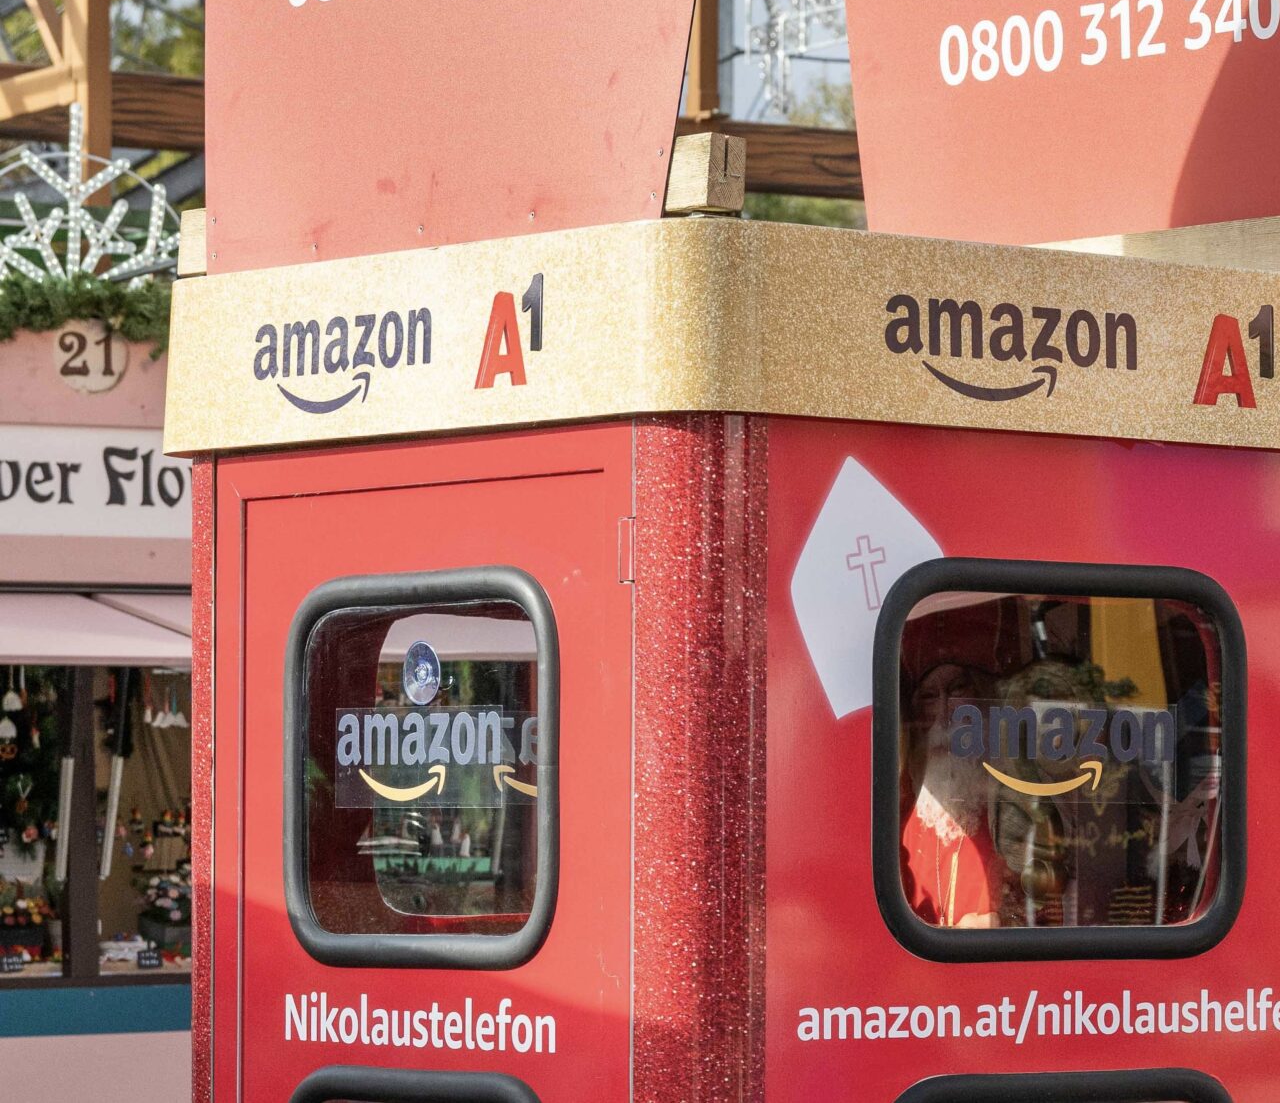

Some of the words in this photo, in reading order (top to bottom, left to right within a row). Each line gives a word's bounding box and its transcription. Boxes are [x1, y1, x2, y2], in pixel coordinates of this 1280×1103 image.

[939, 8, 1065, 87] 0800
[58, 330, 116, 377] 21
[253, 306, 433, 381] amazon
[473, 272, 545, 390] A1
[884, 293, 1138, 371] amazon
[1192, 303, 1276, 409] A1
[102, 445, 193, 509] Flo
[336, 710, 502, 767] amazon
[949, 703, 1176, 763] amazon
[284, 990, 558, 1054] Nikolaustelefon
